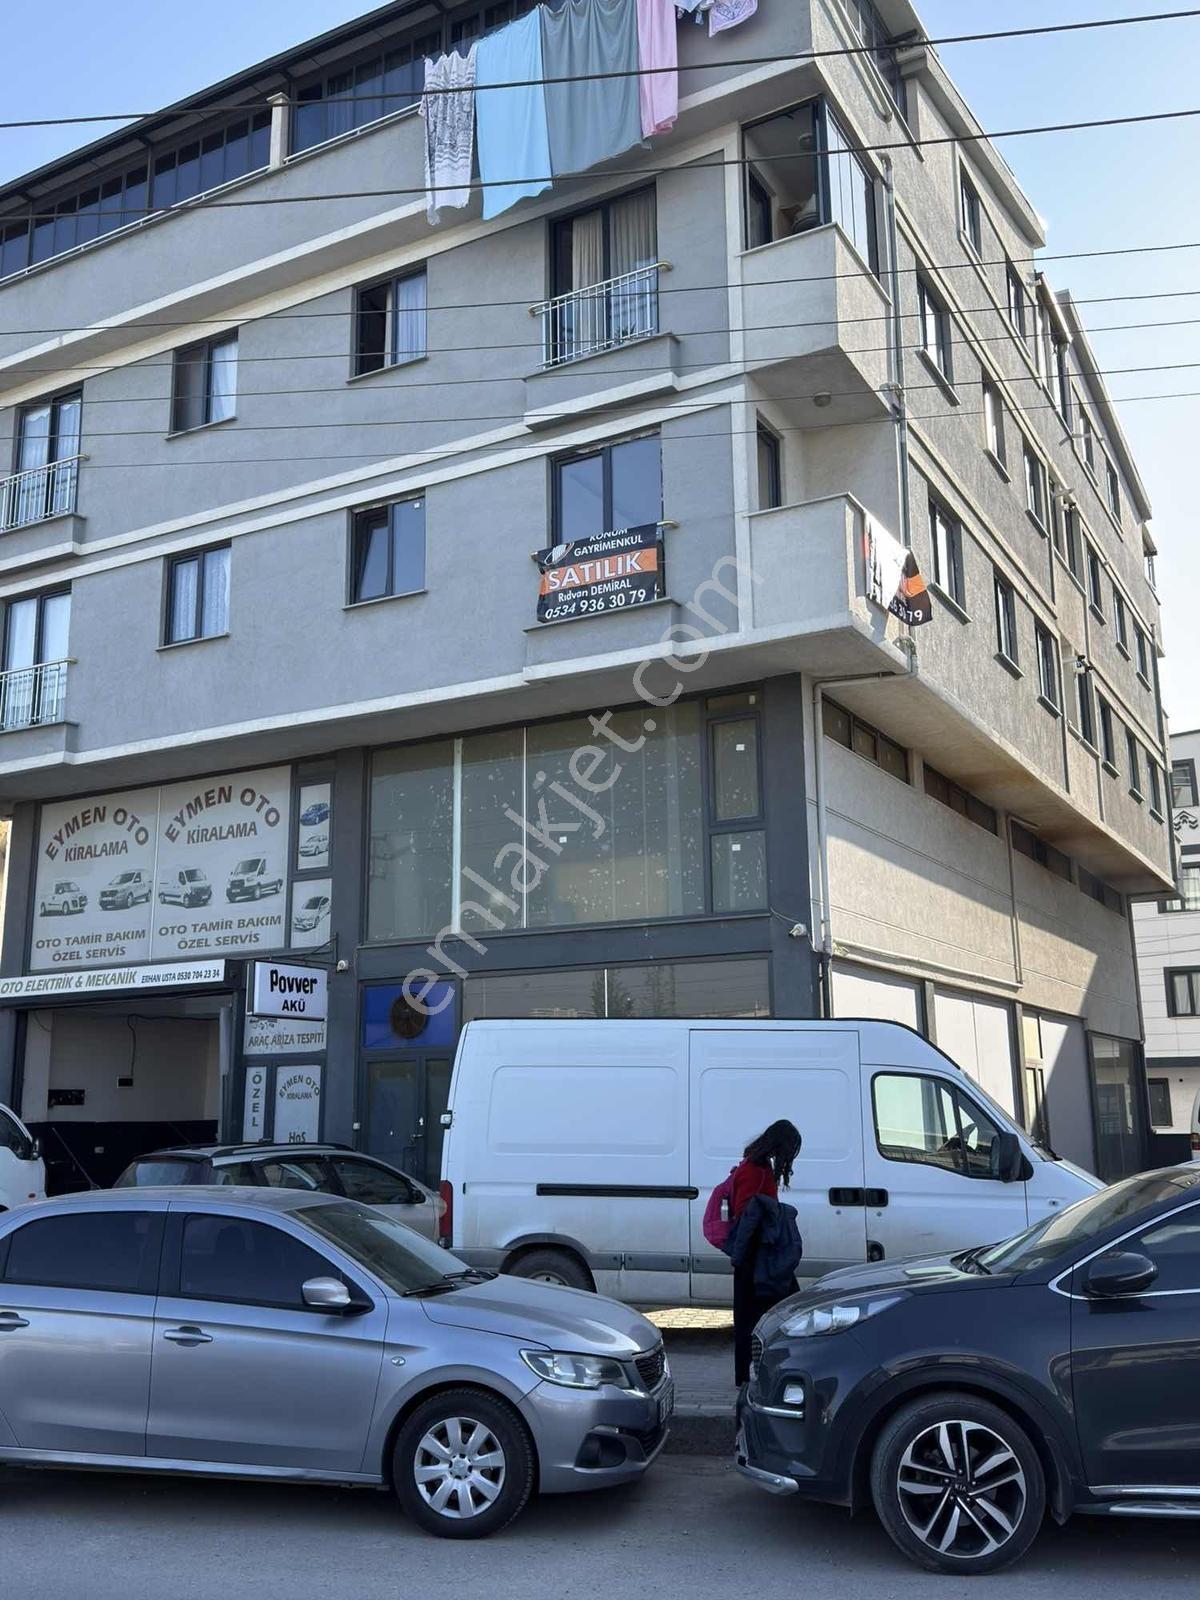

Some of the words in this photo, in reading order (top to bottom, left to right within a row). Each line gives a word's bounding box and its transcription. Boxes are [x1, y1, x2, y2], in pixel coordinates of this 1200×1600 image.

[573, 534, 643, 557] GAYRİMENKUL
[548, 552, 642, 590] SATILIK
[590, 578, 632, 596] DEMİRAL
[545, 602, 576, 619] 0534
[580, 598, 605, 612] 936
[609, 593, 626, 608] 30
[629, 588, 646, 602] 79
[907, 609, 923, 622] 79
[165, 785, 232, 843] EYMEN
[240, 788, 280, 827] OTO
[45, 806, 107, 861] EYMEN
[113, 808, 149, 845] OTO
[187, 821, 258, 845] KİRALAMA
[64, 839, 128, 862] KİRALAMA
[158, 924, 187, 937] OTO
[191, 918, 233, 933] TAMİR
[237, 915, 282, 929] BAKIM
[35, 938, 61, 950] OTO
[64, 932, 102, 946] TAMİR
[105, 929, 146, 943] BAKIM
[177, 937, 211, 950] ÖZEL
[214, 933, 260, 946] SERVİS
[85, 946, 126, 959] SERVİS
[1, 981, 24, 994] OTO
[24, 974, 73, 992] ELEKTRİK
[75, 976, 83, 988] &
[85, 968, 138, 986] MEKANİK
[141, 974, 161, 984] ERHAN
[162, 972, 176, 982] USTA
[177, 971, 191, 981] 0530
[204, 969, 212, 979] 23
[212, 968, 220, 978] 34
[281, 998, 306, 1012] AKÜ
[248, 1035, 270, 1048] ARAÇ
[279, 1075, 304, 1098] EYMEN
[305, 1076, 321, 1096] OTO
